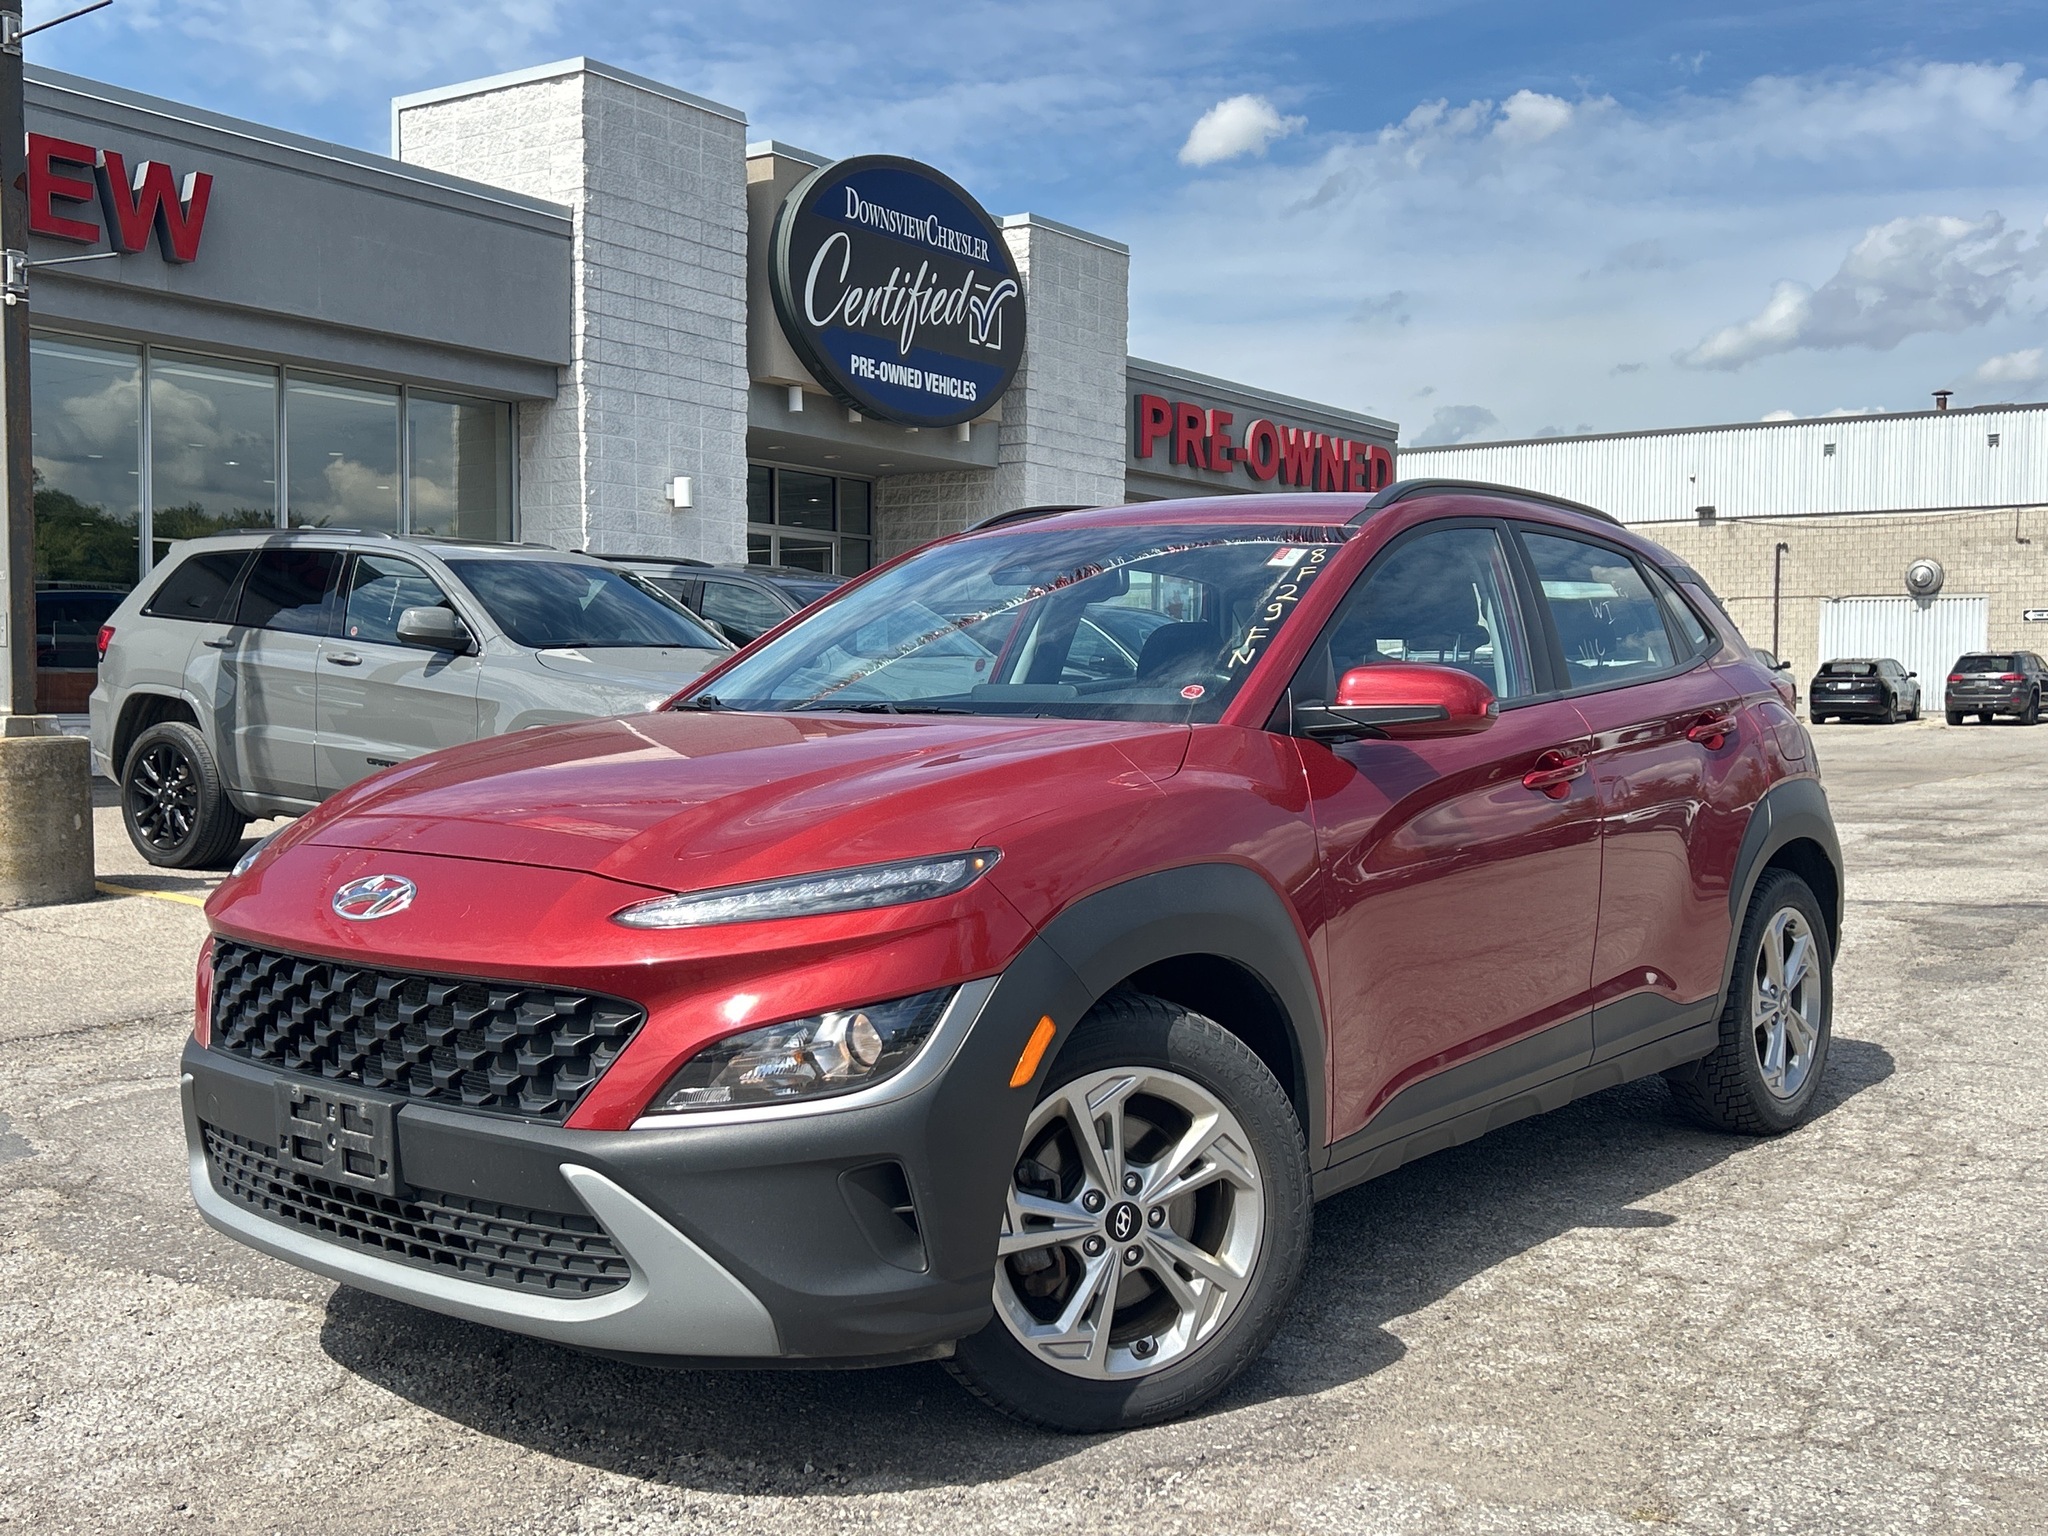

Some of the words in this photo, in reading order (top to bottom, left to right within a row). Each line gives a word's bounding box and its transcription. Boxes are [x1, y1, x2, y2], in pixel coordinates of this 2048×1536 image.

[804, 231, 974, 355] Certified
[851, 354, 922, 389] PRE-OWNED
[924, 371, 977, 401] VEHICLES
[1134, 393, 1394, 493] PRE-OWNED
